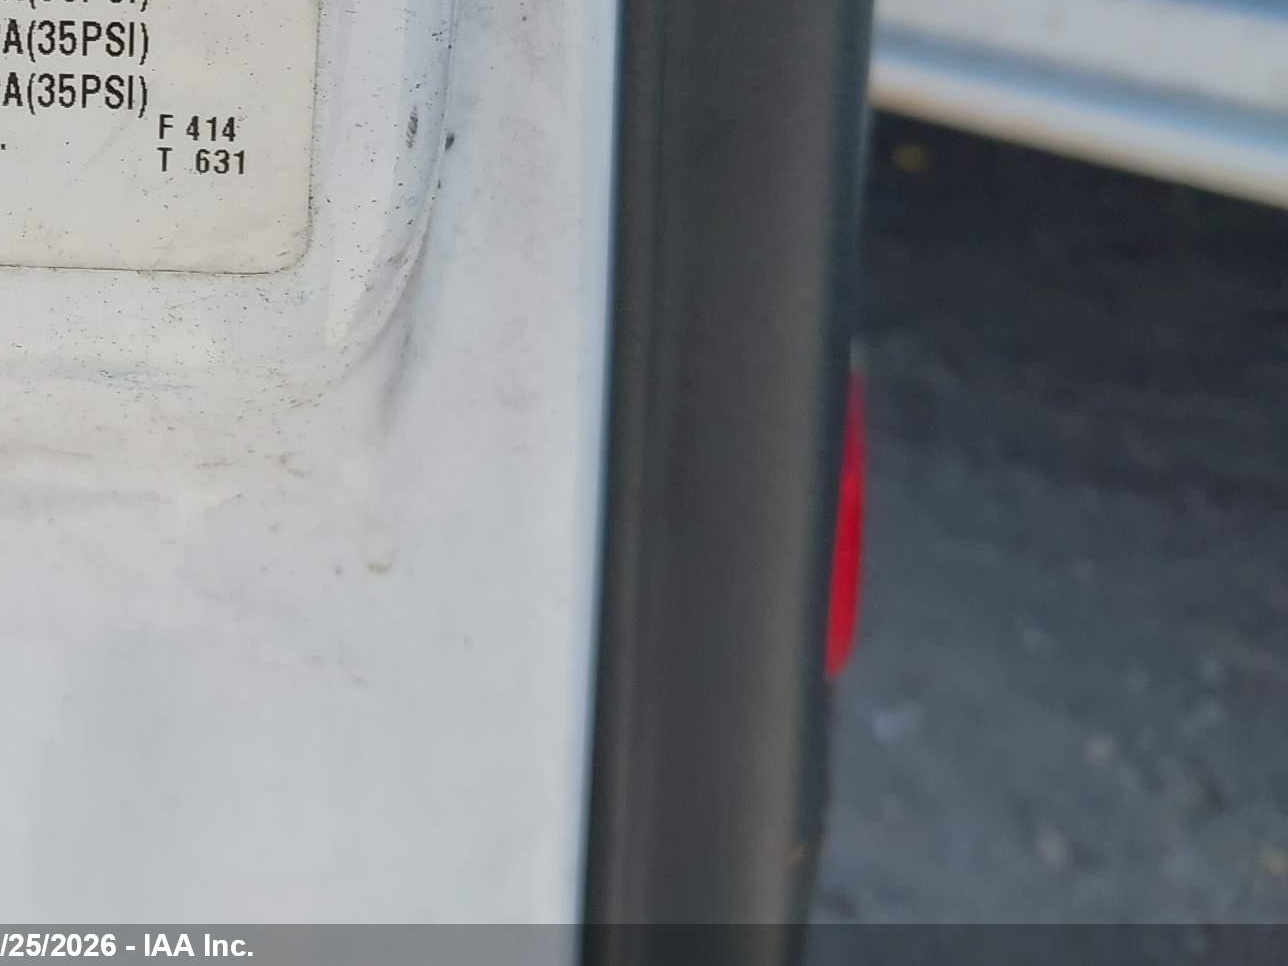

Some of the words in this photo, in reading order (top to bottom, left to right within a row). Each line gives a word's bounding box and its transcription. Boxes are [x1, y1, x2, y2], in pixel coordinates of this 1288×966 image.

[159, 114, 173, 139] F
[186, 116, 236, 142] 414
[157, 147, 173, 172] T
[196, 149, 244, 175] 631
